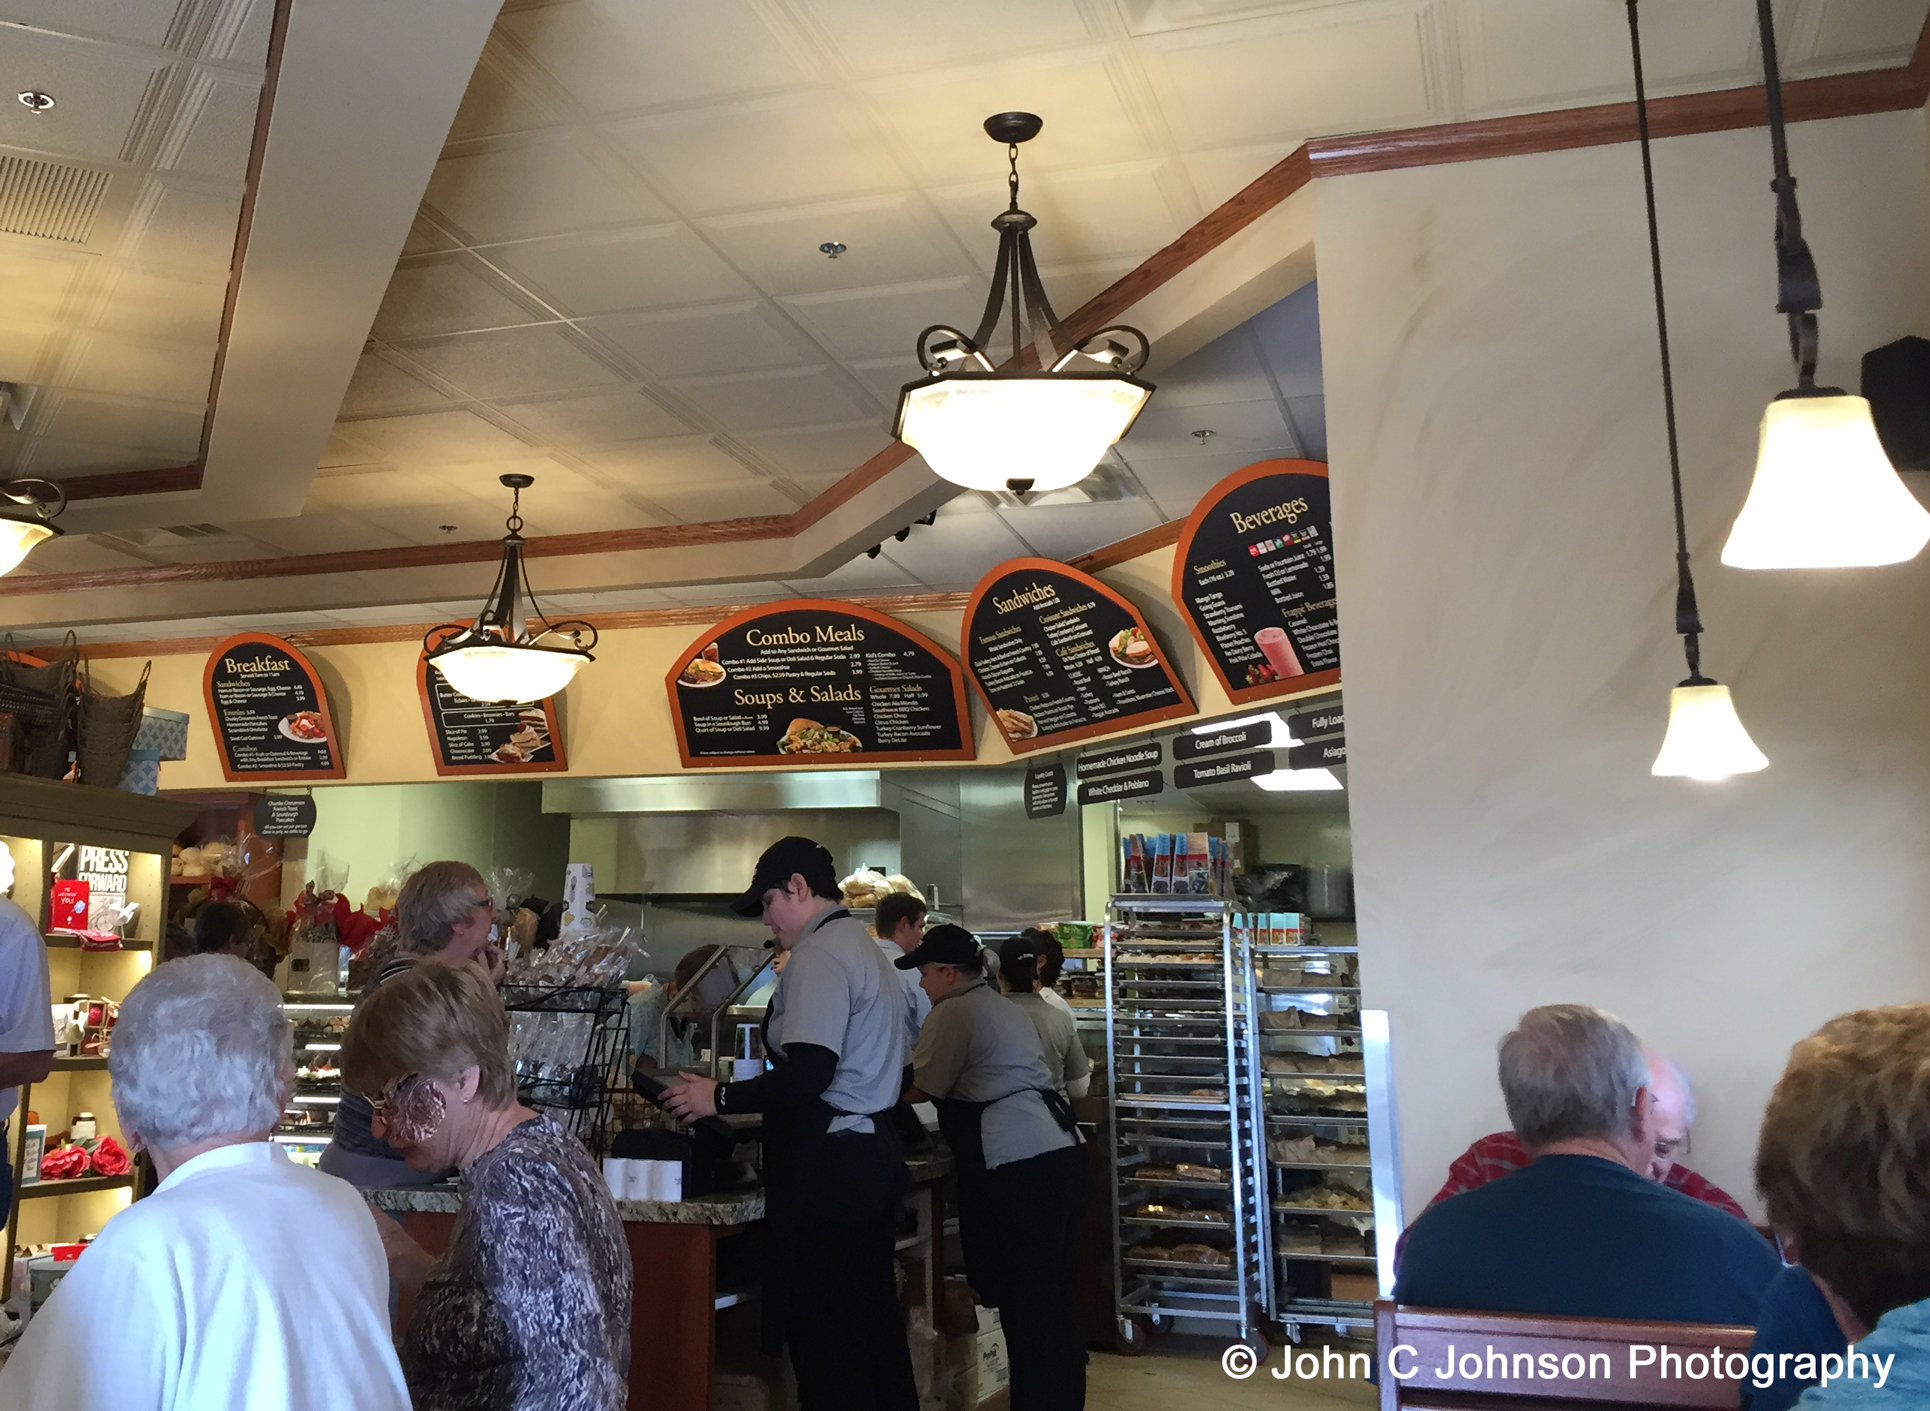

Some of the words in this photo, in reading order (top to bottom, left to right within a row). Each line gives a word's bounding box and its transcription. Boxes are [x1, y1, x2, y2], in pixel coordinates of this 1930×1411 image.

[1230, 498, 1308, 534] Beverages
[993, 582, 1055, 614] Sandwiches
[746, 627, 810, 646] Combo
[815, 624, 864, 642] Meals
[225, 654, 290, 673] Breakfast
[734, 689, 783, 709] Soups
[789, 688, 806, 702] &
[810, 684, 861, 702] Salads
[902, 684, 922, 692] Salads
[1312, 717, 1328, 728] Fully
[1195, 740, 1214, 749] Cream
[1222, 732, 1246, 744] Broccoli
[1078, 760, 1106, 771] Homemade
[1106, 756, 1125, 766] Chicken
[1125, 752, 1144, 763] Noodle
[1144, 750, 1158, 760] Soup
[1322, 745, 1345, 760] Asiago
[1193, 769, 1215, 778] Tomato
[1216, 764, 1230, 775] Basil
[1231, 761, 1251, 772] Ravioli
[1088, 787, 1102, 796] White
[1102, 783, 1123, 794] Cheddar
[1128, 780, 1149, 790] Poblano
[80, 846, 129, 873] PRESS
